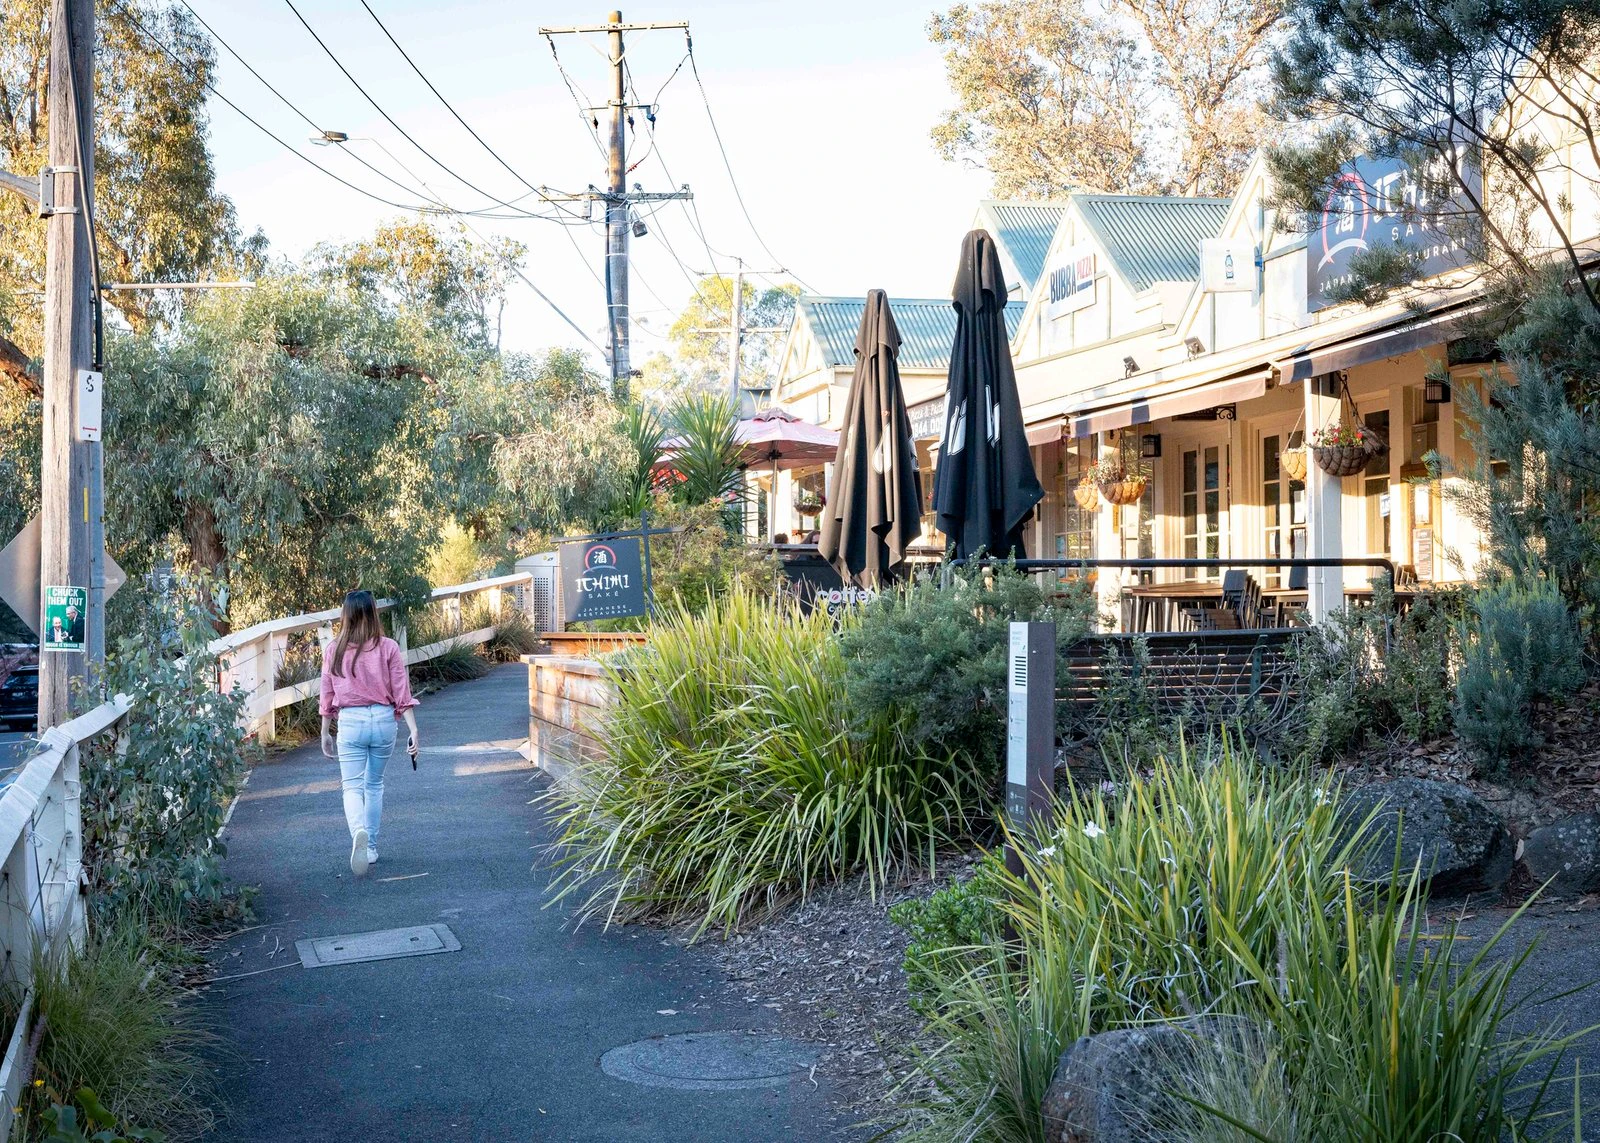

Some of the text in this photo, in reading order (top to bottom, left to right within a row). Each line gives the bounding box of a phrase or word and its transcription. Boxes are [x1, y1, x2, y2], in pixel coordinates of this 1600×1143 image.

[1077, 256, 1093, 281] PIZZA
[1050, 261, 1077, 304] BUBBA
[593, 550, 607, 564] 酒
[575, 574, 630, 592] ICHIMI
[51, 588, 78, 597] CHUCK
[47, 596, 84, 606] THEM OUT
[583, 604, 626, 612] JAPANESE
